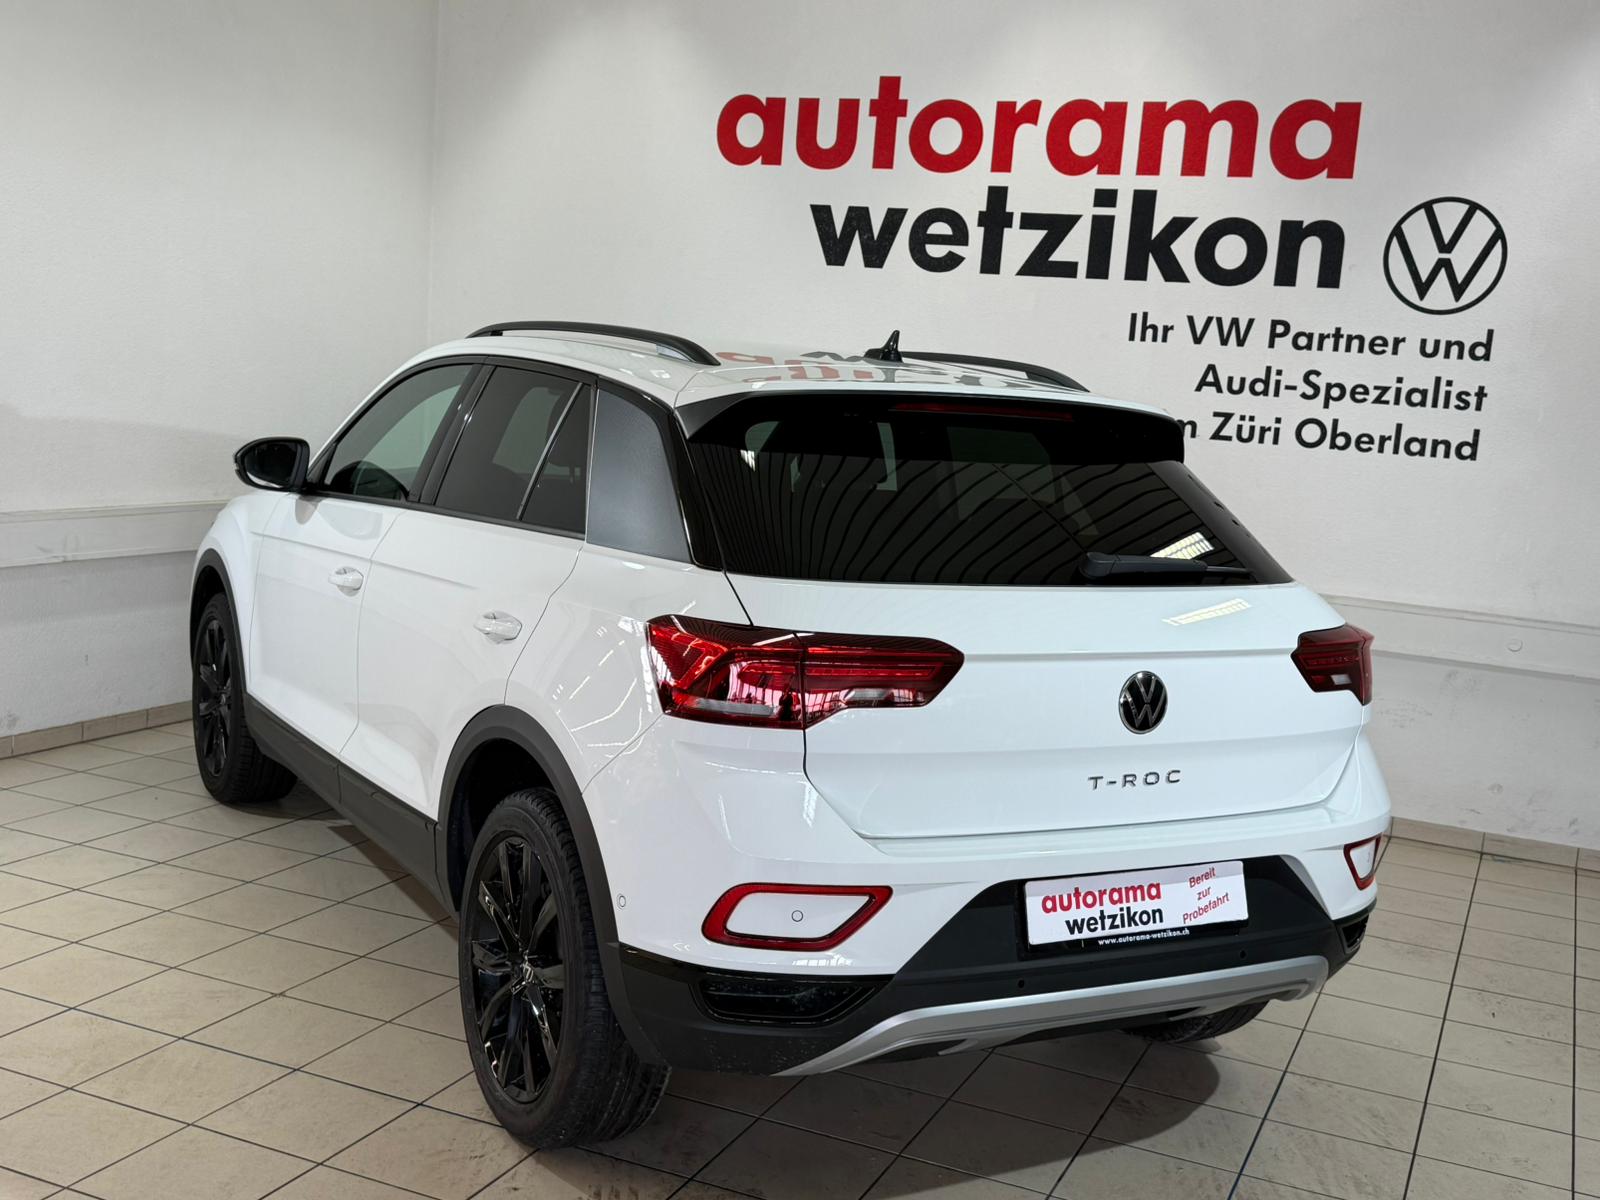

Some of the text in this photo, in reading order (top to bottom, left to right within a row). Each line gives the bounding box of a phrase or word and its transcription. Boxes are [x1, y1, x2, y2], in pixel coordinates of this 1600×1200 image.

[717, 76, 1361, 180] autorama
[809, 185, 1346, 289] wetzikon
[1128, 312, 1495, 362] Ihr VW Partner und
[1194, 363, 1489, 412] Audi-Spezialist
[1208, 411, 1282, 446] Züri
[1294, 417, 1481, 462] Oberland
[1088, 769, 1182, 790] T-ROC
[1188, 866, 1217, 889] Bereit
[1196, 885, 1212, 902] zur
[1041, 881, 1162, 914] autorama
[1182, 891, 1231, 925] Probefahrt
[1065, 906, 1164, 936] wetzikon
[1098, 928, 1190, 946] www.autorama-wetzikon.ch
